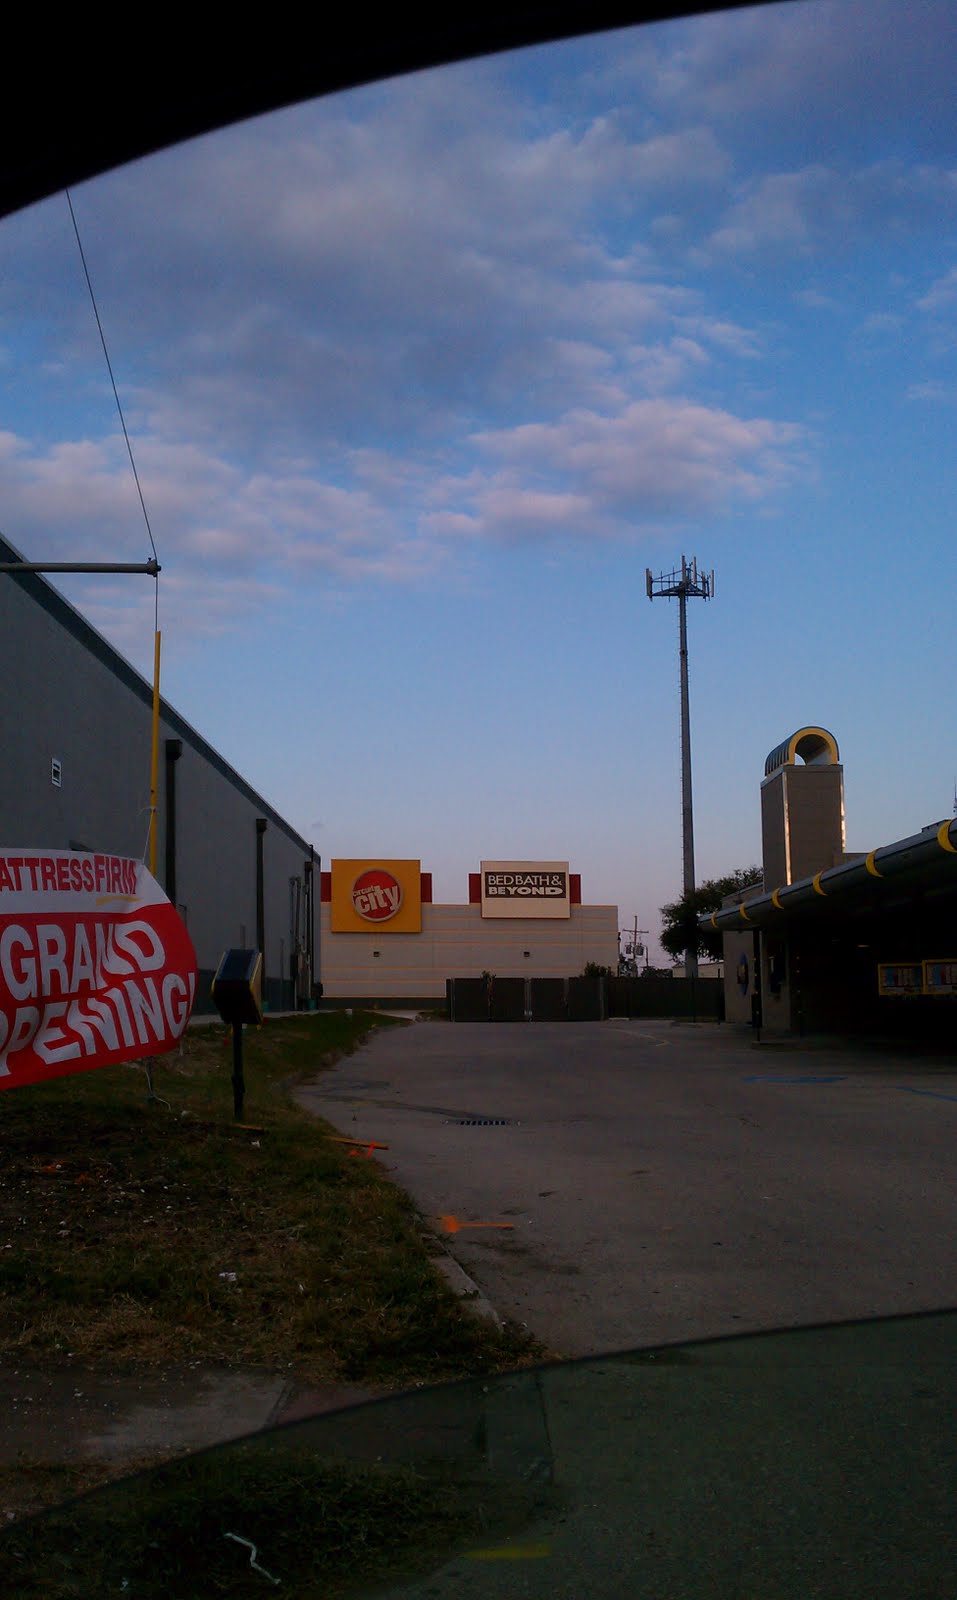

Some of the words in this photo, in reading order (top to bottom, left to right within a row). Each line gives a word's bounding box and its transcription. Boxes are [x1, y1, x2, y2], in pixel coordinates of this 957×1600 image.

[0, 855, 138, 895] ATTRESSFIRM
[488, 875, 514, 886] BED
[515, 875, 550, 886] BATH
[551, 875, 562, 886] &
[355, 885, 399, 914] city
[488, 886, 563, 895] BEYOND
[1, 920, 166, 1001] GRAND
